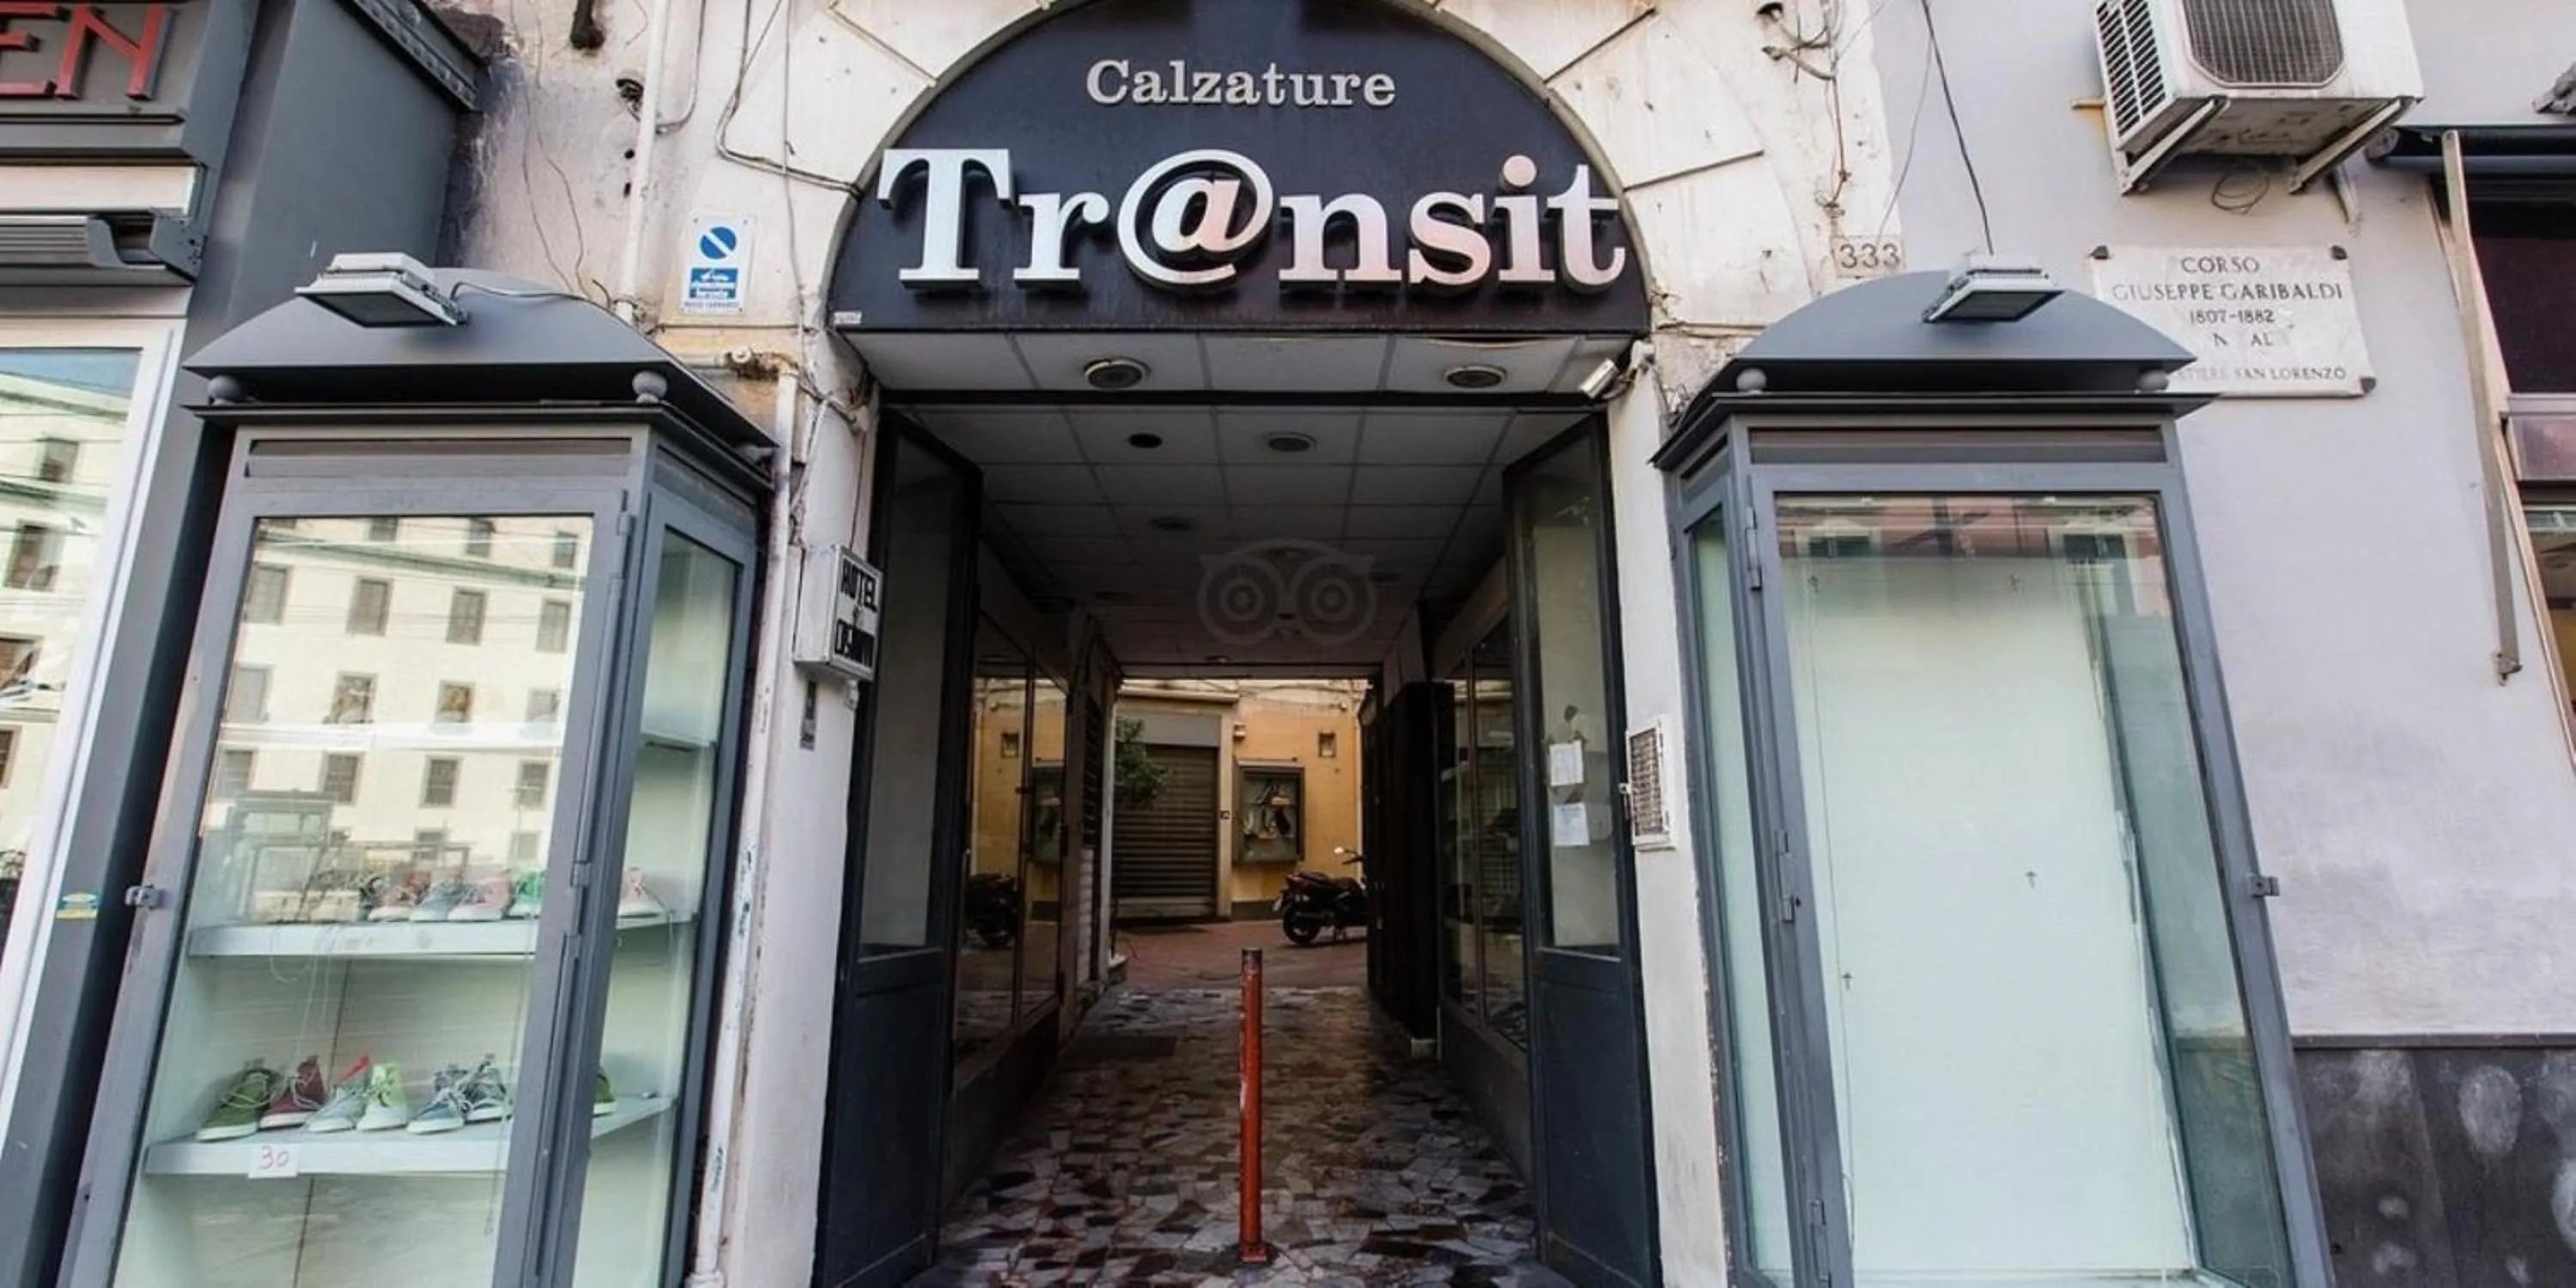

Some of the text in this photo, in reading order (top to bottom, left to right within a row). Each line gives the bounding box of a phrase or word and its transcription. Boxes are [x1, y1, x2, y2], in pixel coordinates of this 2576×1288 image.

[1085, 59, 1397, 107] Calzature
[877, 148, 1626, 293] Tr@nsit
[1839, 242, 1900, 270] 333
[2180, 256, 2260, 273] CORSO
[2111, 282, 2343, 301] GIUSEPPE GARIBALDI
[2190, 308, 2275, 324] 1807-1882
[2234, 367, 2266, 380] SAN
[2270, 366, 2347, 380] LORENZO
[260, 1145, 289, 1170] 30
